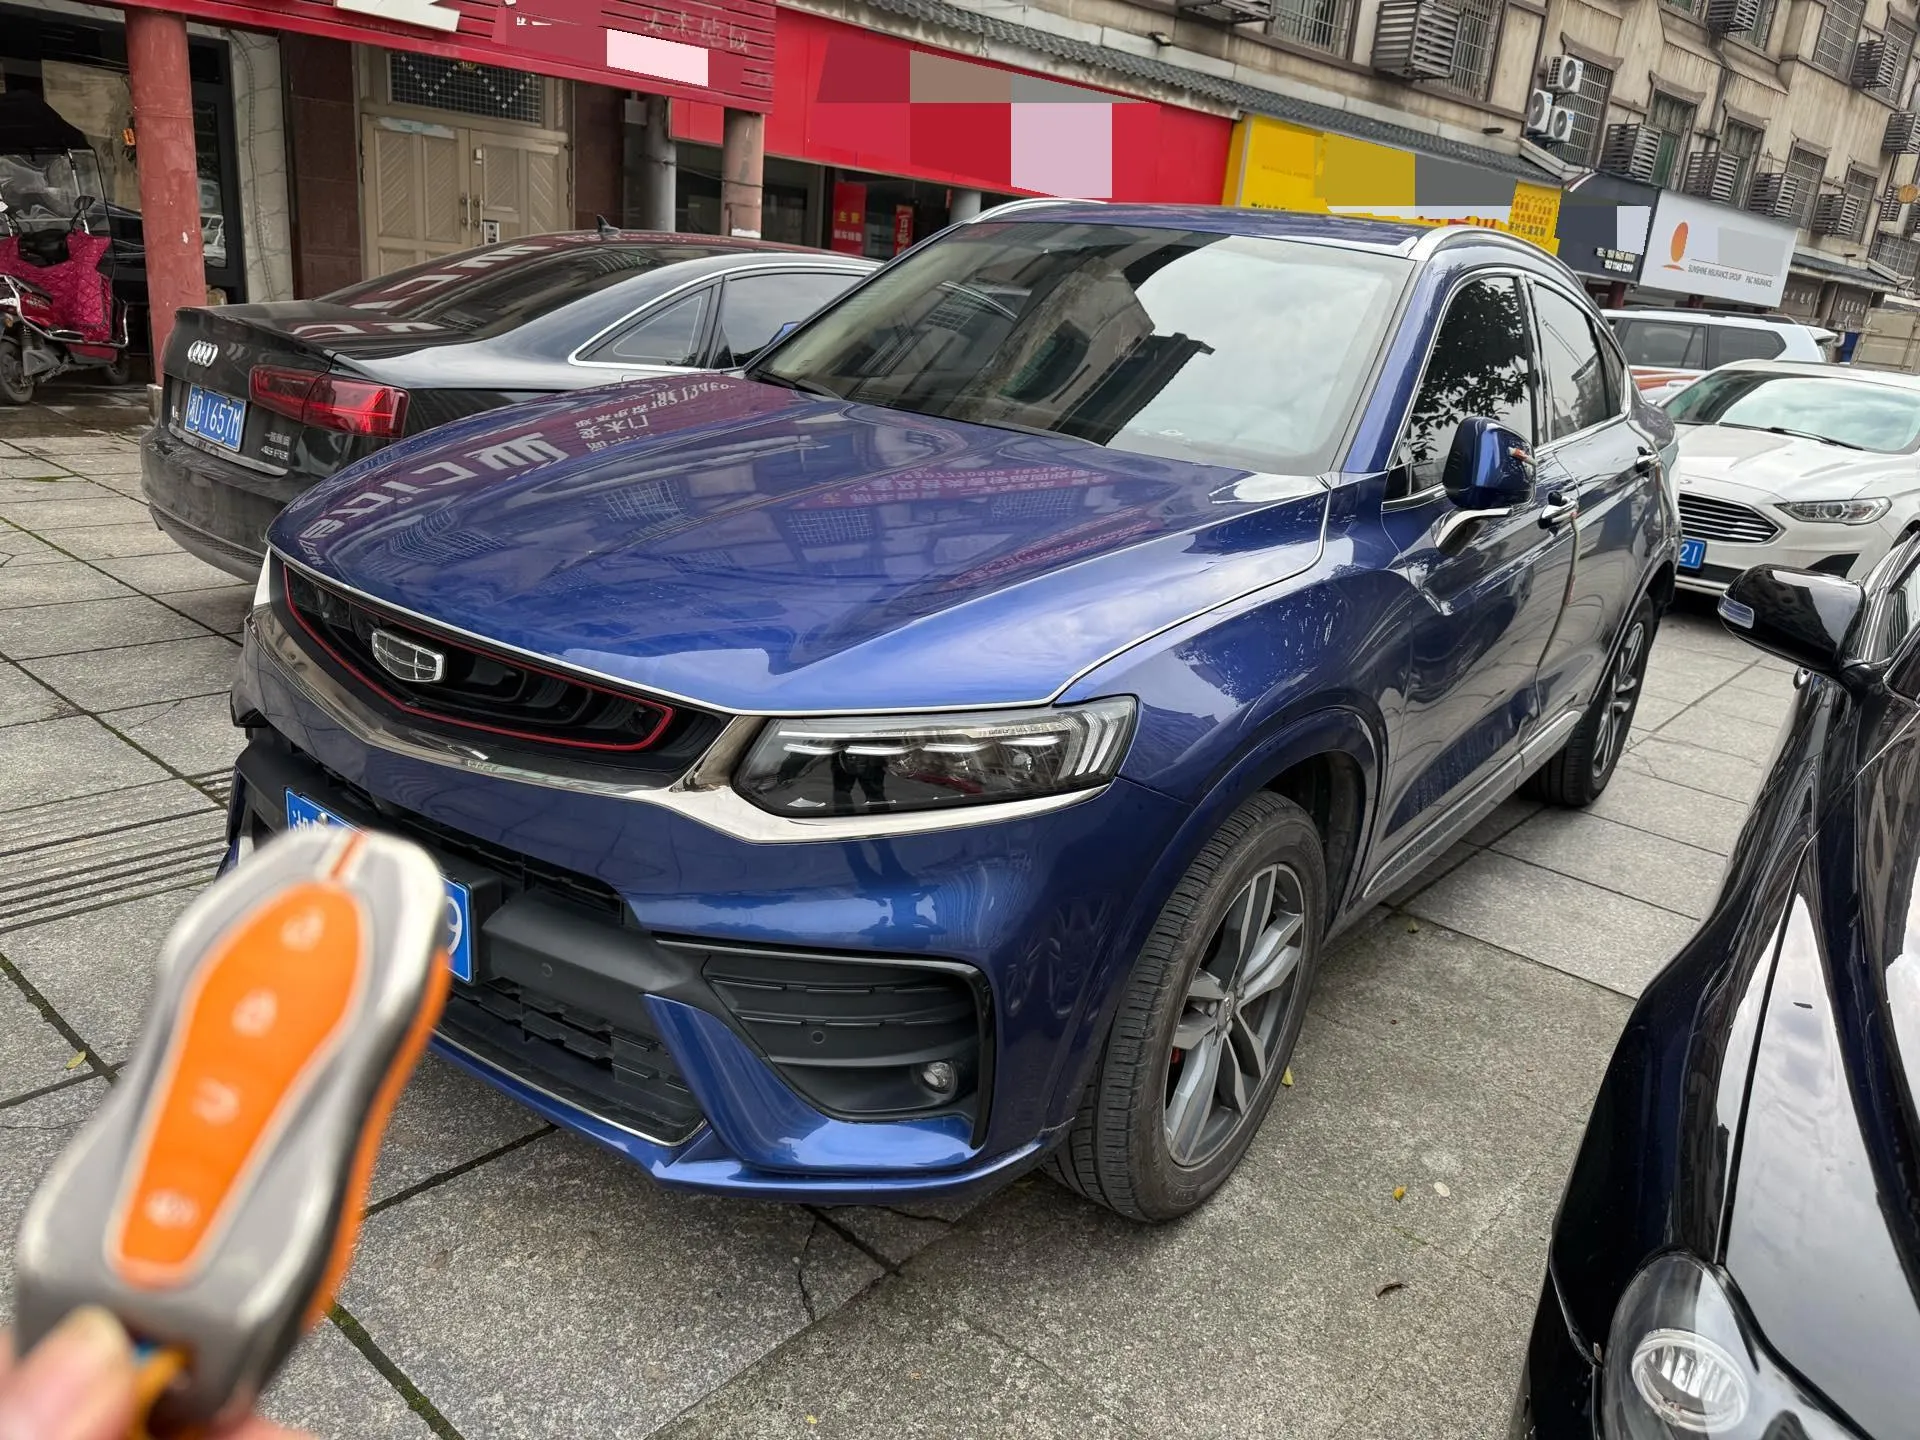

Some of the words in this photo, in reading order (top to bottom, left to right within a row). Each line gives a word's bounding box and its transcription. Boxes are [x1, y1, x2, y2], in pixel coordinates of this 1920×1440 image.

[1688, 264, 1708, 276] SUNSHINE
[1708, 269, 1728, 280] INSURANCE
[1728, 271, 1742, 282] GROUP
[1754, 277, 1773, 288] INSURANCE
